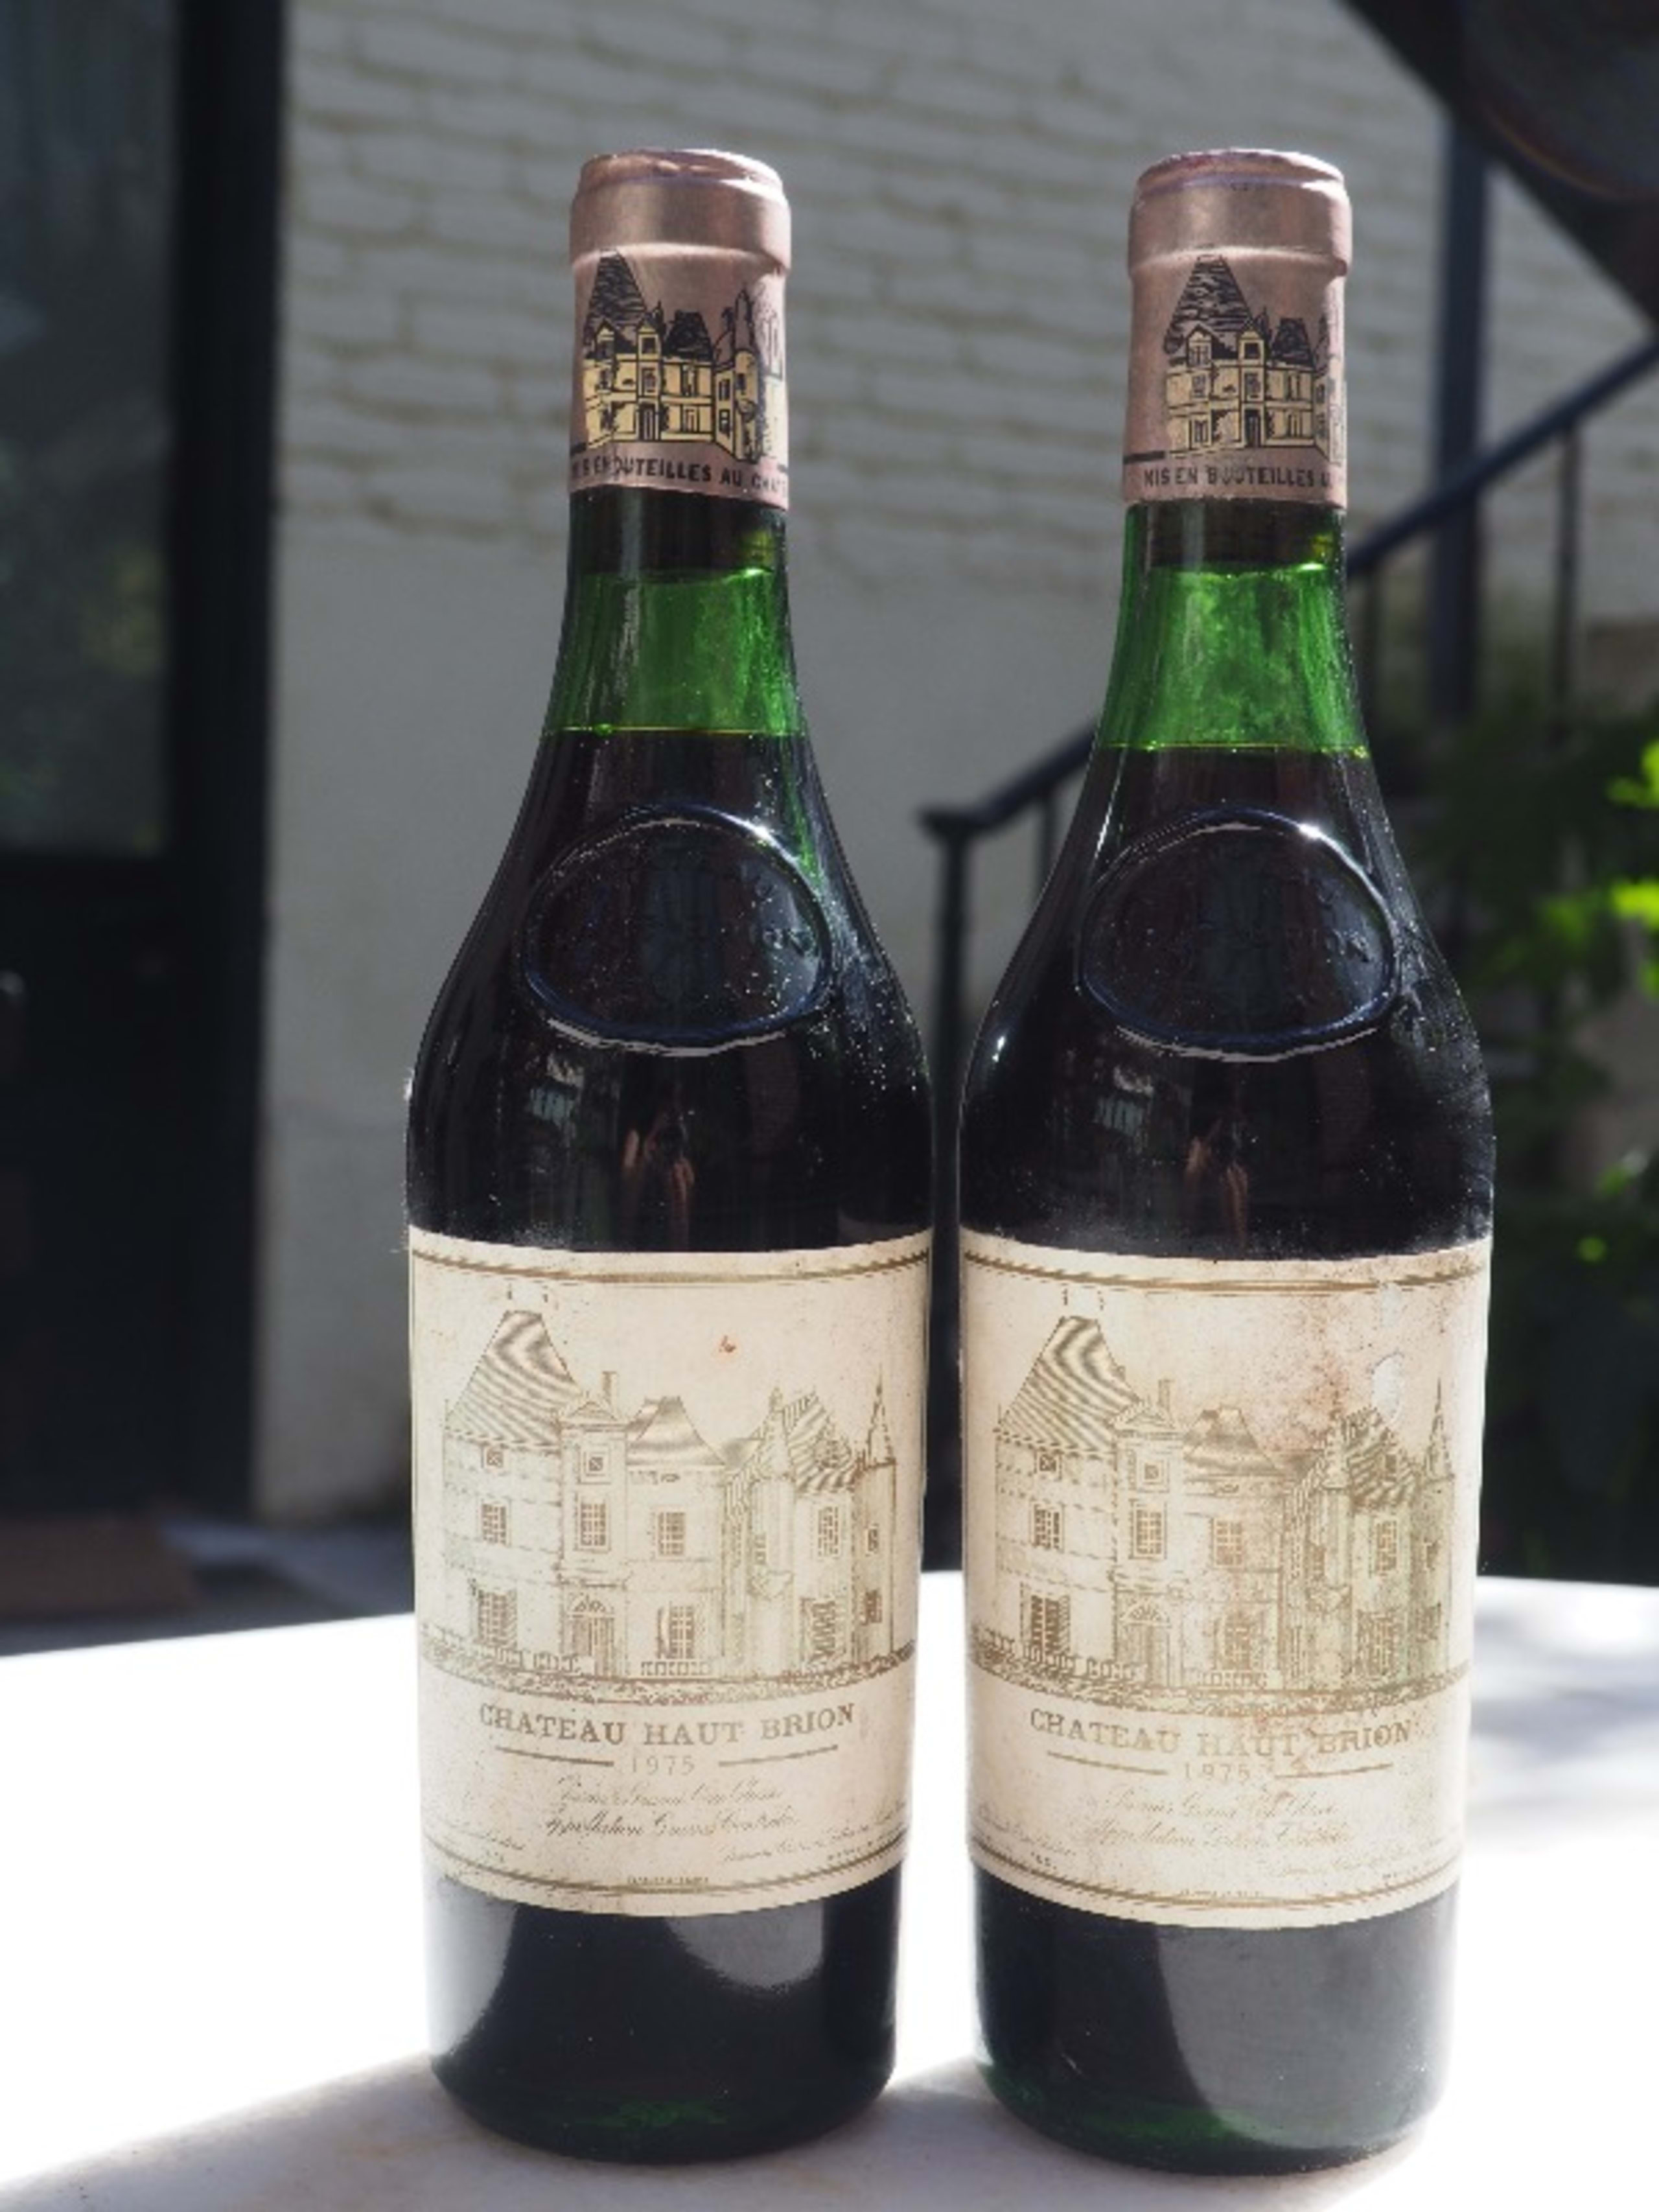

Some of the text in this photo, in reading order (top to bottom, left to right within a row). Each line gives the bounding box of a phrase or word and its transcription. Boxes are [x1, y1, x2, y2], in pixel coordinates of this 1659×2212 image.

[719, 467, 742, 487] AU
[1144, 469, 1168, 487] MIS
[1174, 467, 1198, 485] EN
[479, 1702, 855, 1745] CHATEAU HAUT BRION
[1030, 1708, 1414, 1757] CHATEAU HAUT BRION
[631, 1754, 696, 1776] 1975
[1183, 1762, 1252, 1786] 1975
